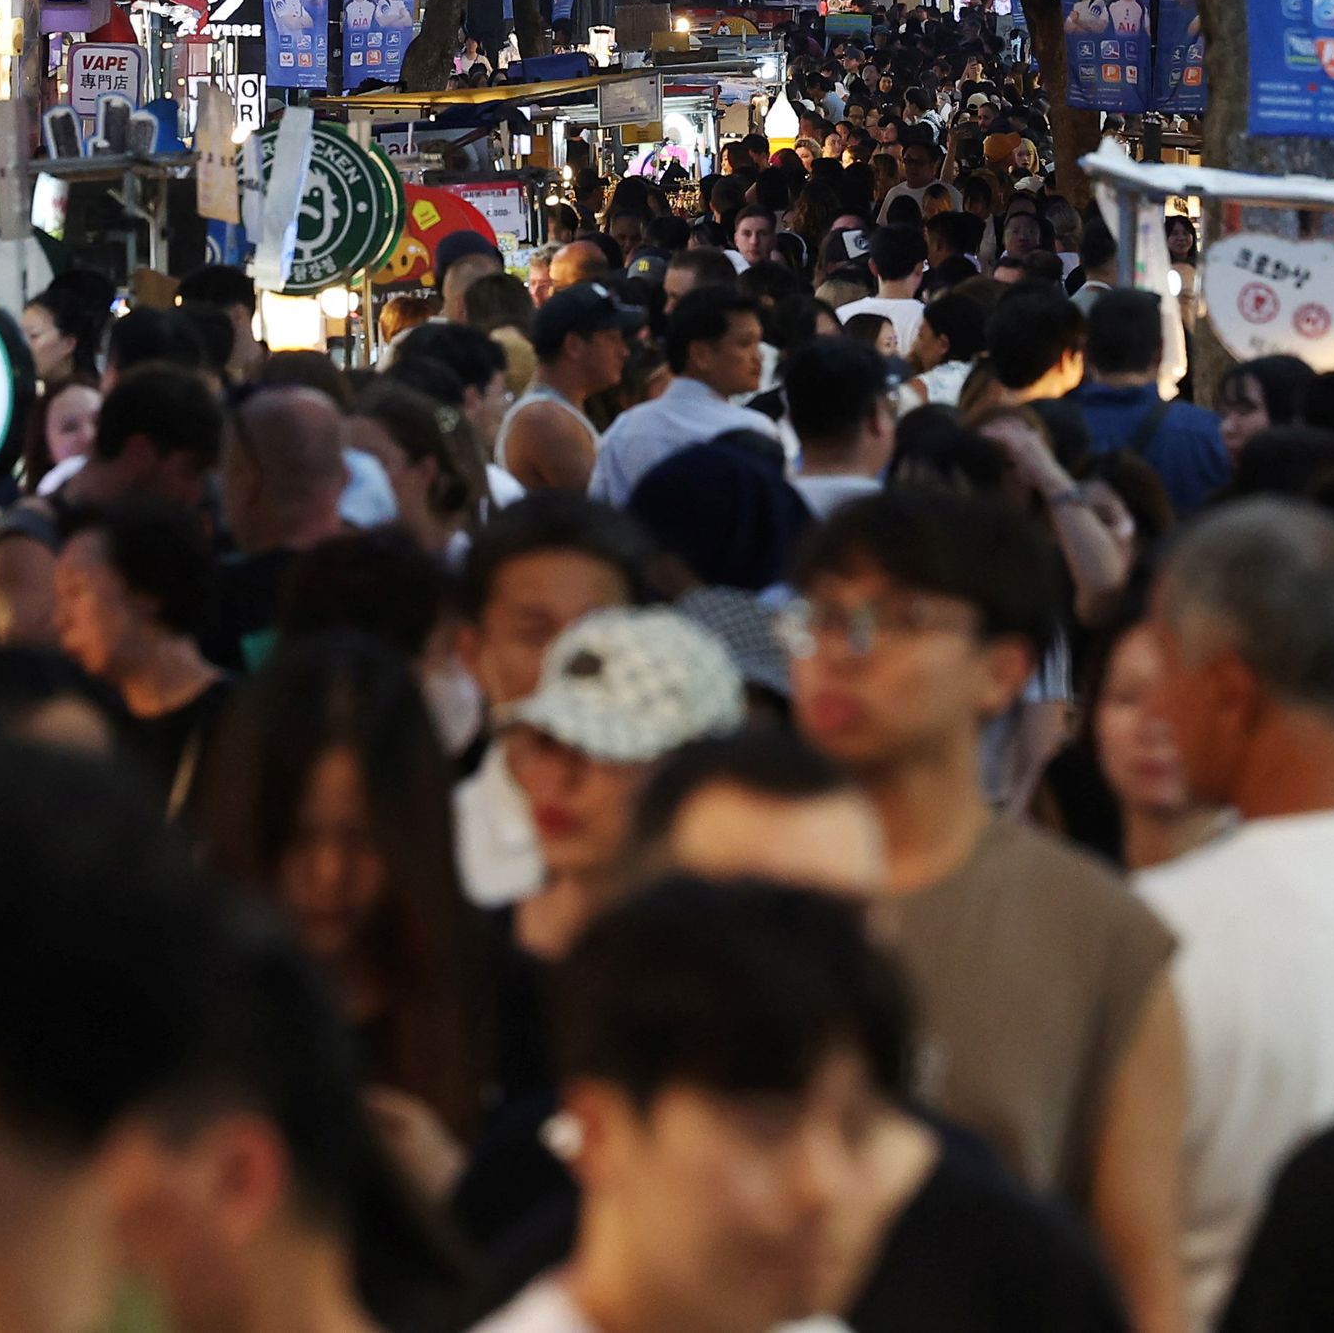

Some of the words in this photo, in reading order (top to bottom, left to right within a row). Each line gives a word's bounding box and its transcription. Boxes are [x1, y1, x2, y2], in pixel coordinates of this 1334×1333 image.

[81, 55, 128, 72] VAPE
[79, 73, 129, 92] 專門店
